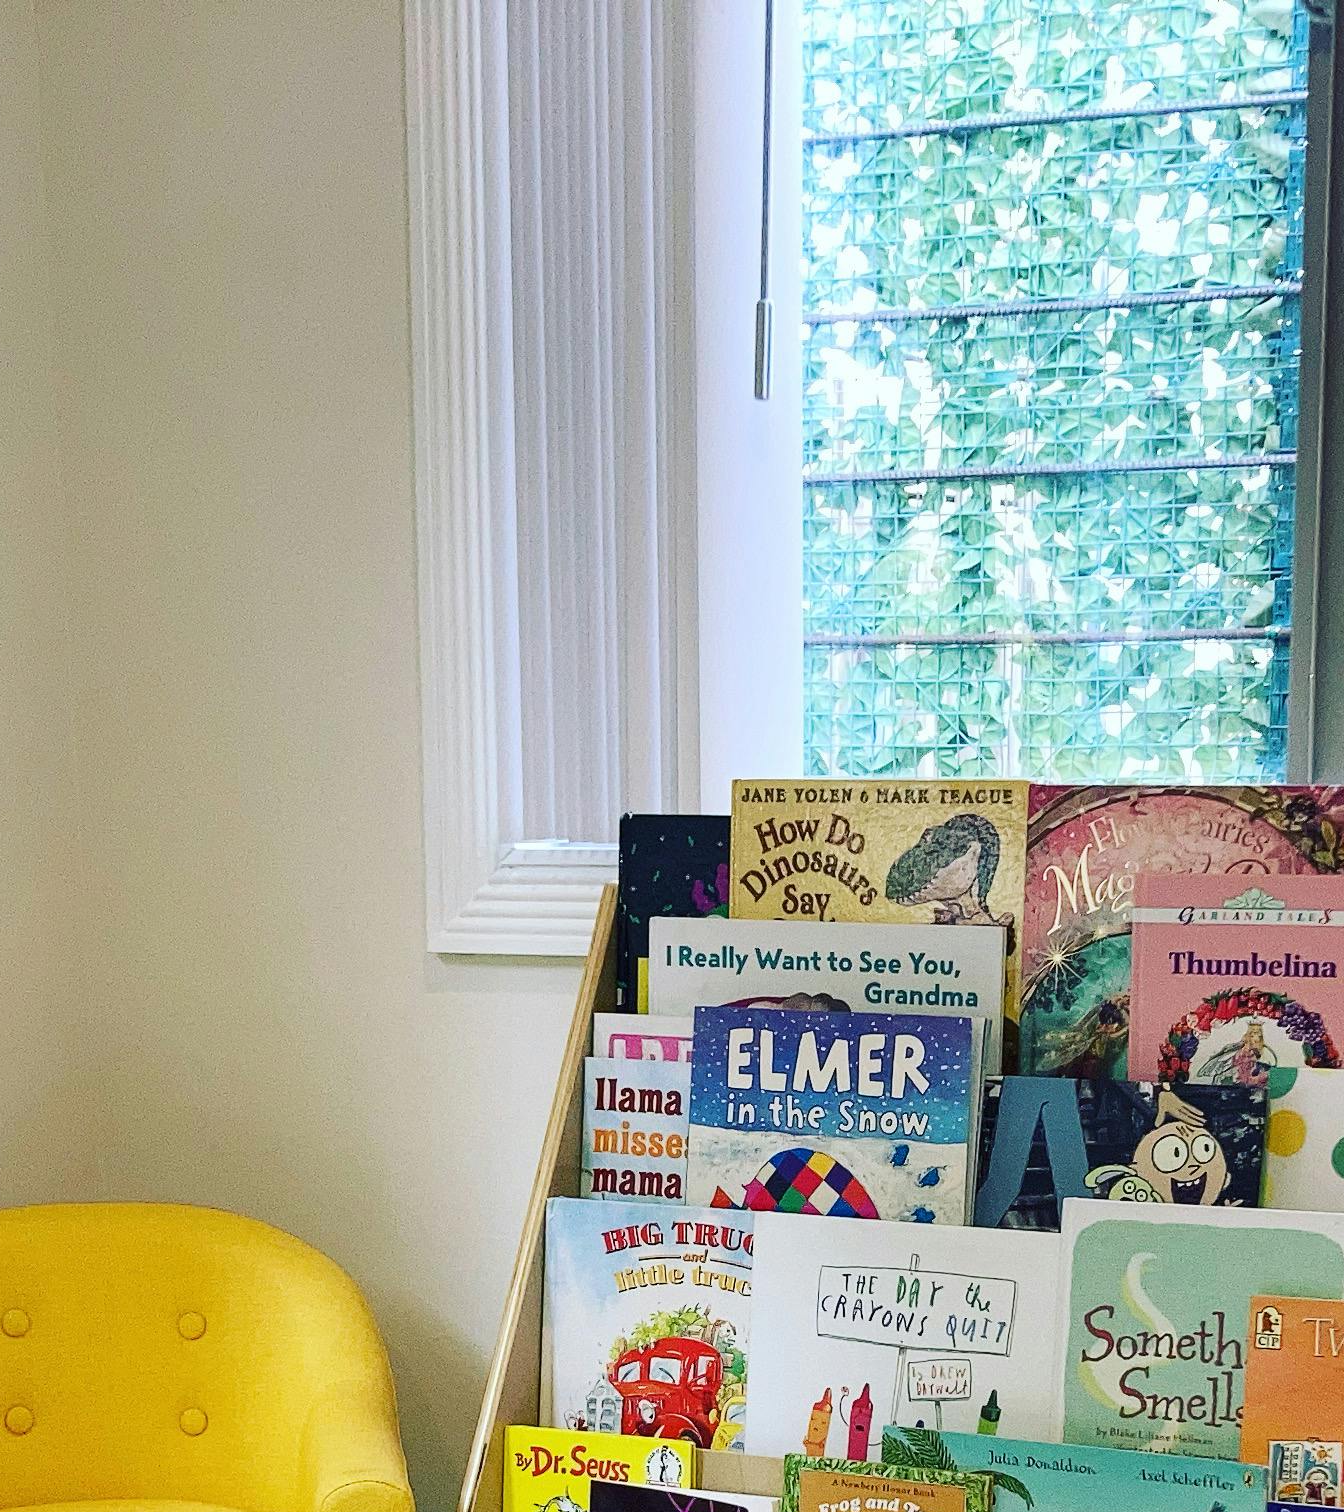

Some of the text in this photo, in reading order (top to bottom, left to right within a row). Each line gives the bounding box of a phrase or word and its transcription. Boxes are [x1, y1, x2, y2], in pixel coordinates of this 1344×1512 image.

[741, 788, 786, 803] JANE
[794, 788, 853, 804] YOLEN
[875, 788, 930, 804] MARK
[939, 789, 1014, 805] TEAGUE
[754, 813, 866, 855] How Do
[740, 850, 878, 906] Dinosaurs
[782, 884, 831, 921] Say
[1178, 906, 1334, 926] GARLAND TALES
[666, 945, 961, 978] I Really Want to See You,
[1168, 951, 1338, 979] Thumbelina
[864, 981, 979, 1008] Grandma
[726, 1027, 932, 1100] ELMER
[595, 1077, 684, 1116] llama
[727, 1093, 930, 1137] in the Snow
[591, 1167, 683, 1199] mama
[601, 1222, 665, 1255] BIG
[682, 1249, 708, 1264] and
[614, 1263, 685, 1294] little
[842, 1273, 991, 1313] THE DAY the
[821, 1294, 1007, 1348] CRAYONS QUIT
[931, 1365, 967, 1380] DREW
[515, 1452, 532, 1472] By
[530, 1446, 567, 1477] Dr.
[570, 1445, 631, 1483] Seuss
[988, 1450, 1236, 1492] Julia Donaldson Axel Scheffler
[831, 1479, 839, 1487] A
[841, 1479, 879, 1492] Newbery
[865, 1497, 900, 1512] and
